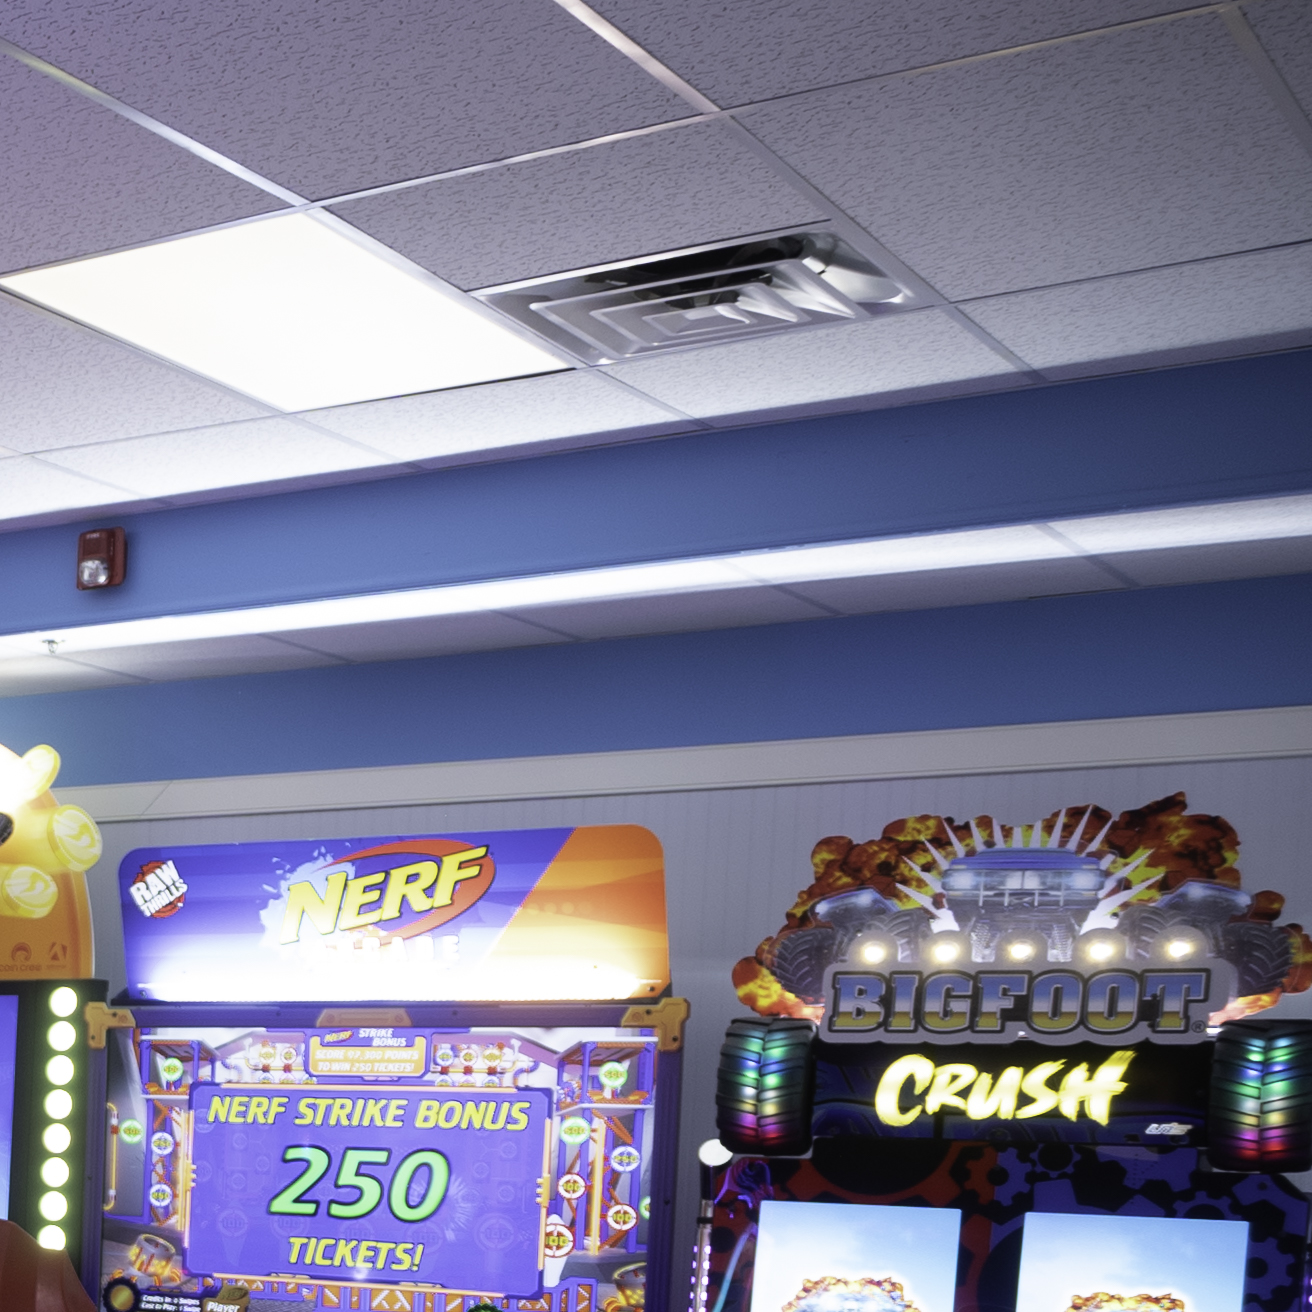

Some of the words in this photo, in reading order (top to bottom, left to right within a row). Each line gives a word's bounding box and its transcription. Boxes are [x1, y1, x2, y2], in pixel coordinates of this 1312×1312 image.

[129, 859, 181, 906] RAW
[139, 878, 189, 918] THRILLS
[279, 844, 491, 945] NERF
[306, 935, 460, 964] CADE
[830, 967, 1210, 1034] BIGFOOT
[358, 1027, 394, 1038] STRIKE
[371, 1037, 407, 1047] BONUS
[315, 1049, 345, 1060] SCORE
[384, 1049, 420, 1060] POINTS
[317, 1060, 331, 1071] TO
[331, 1061, 352, 1071] WIN
[372, 1061, 415, 1073] TICKETS!
[874, 1050, 1139, 1128] CRUSH
[206, 1095, 290, 1126] NERF
[293, 1097, 406, 1130] STRIKE
[414, 1099, 531, 1133] BONUS
[269, 1144, 451, 1222] 250
[287, 1235, 423, 1272] TICKETS!
